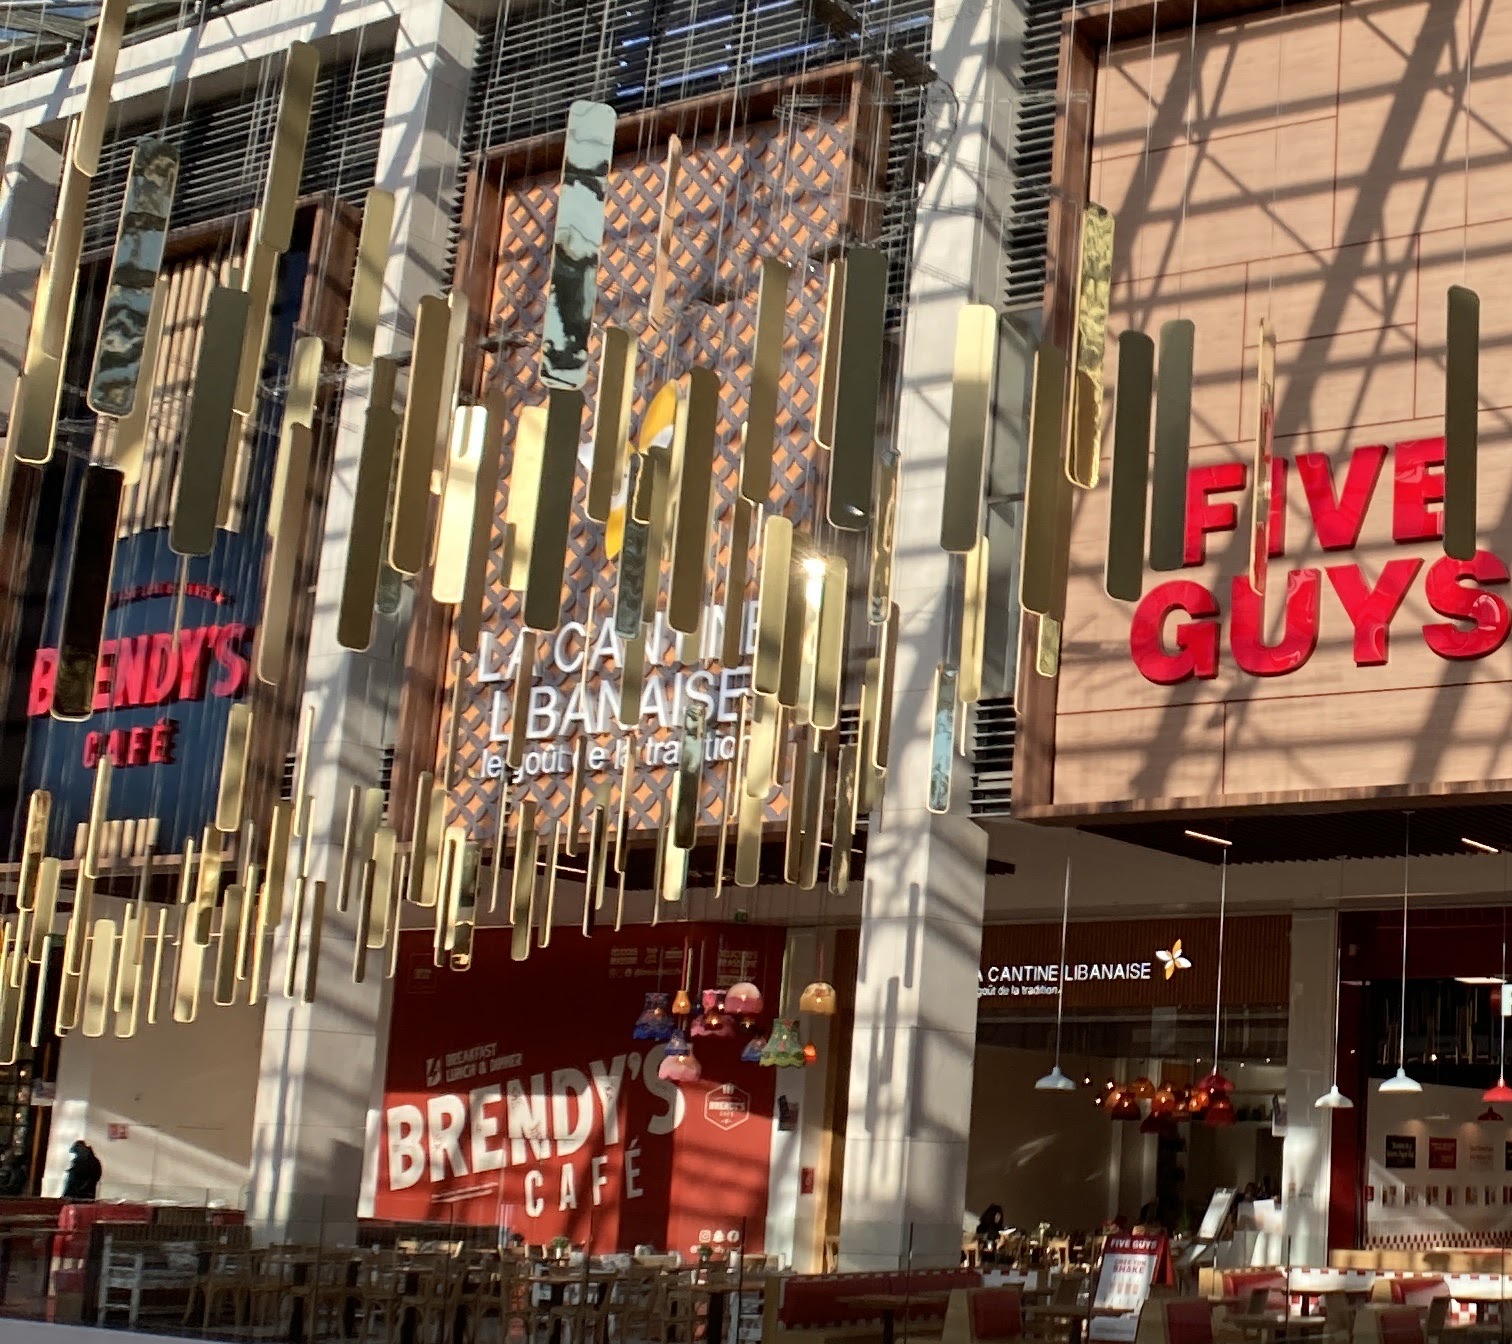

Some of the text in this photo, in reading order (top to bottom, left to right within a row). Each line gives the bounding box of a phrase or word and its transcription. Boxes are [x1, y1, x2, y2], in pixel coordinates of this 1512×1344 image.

[1182, 437, 1445, 566] FIVE
[27, 623, 249, 717] BENDY'S
[489, 666, 752, 742] LBANAISE
[82, 718, 172, 769] CAFÉ
[988, 965, 1059, 983] CANTINE
[1064, 962, 1152, 981] LIBANAISE
[386, 1042, 686, 1191] BRENDY'S
[523, 1139, 644, 1218] CAFÉ
